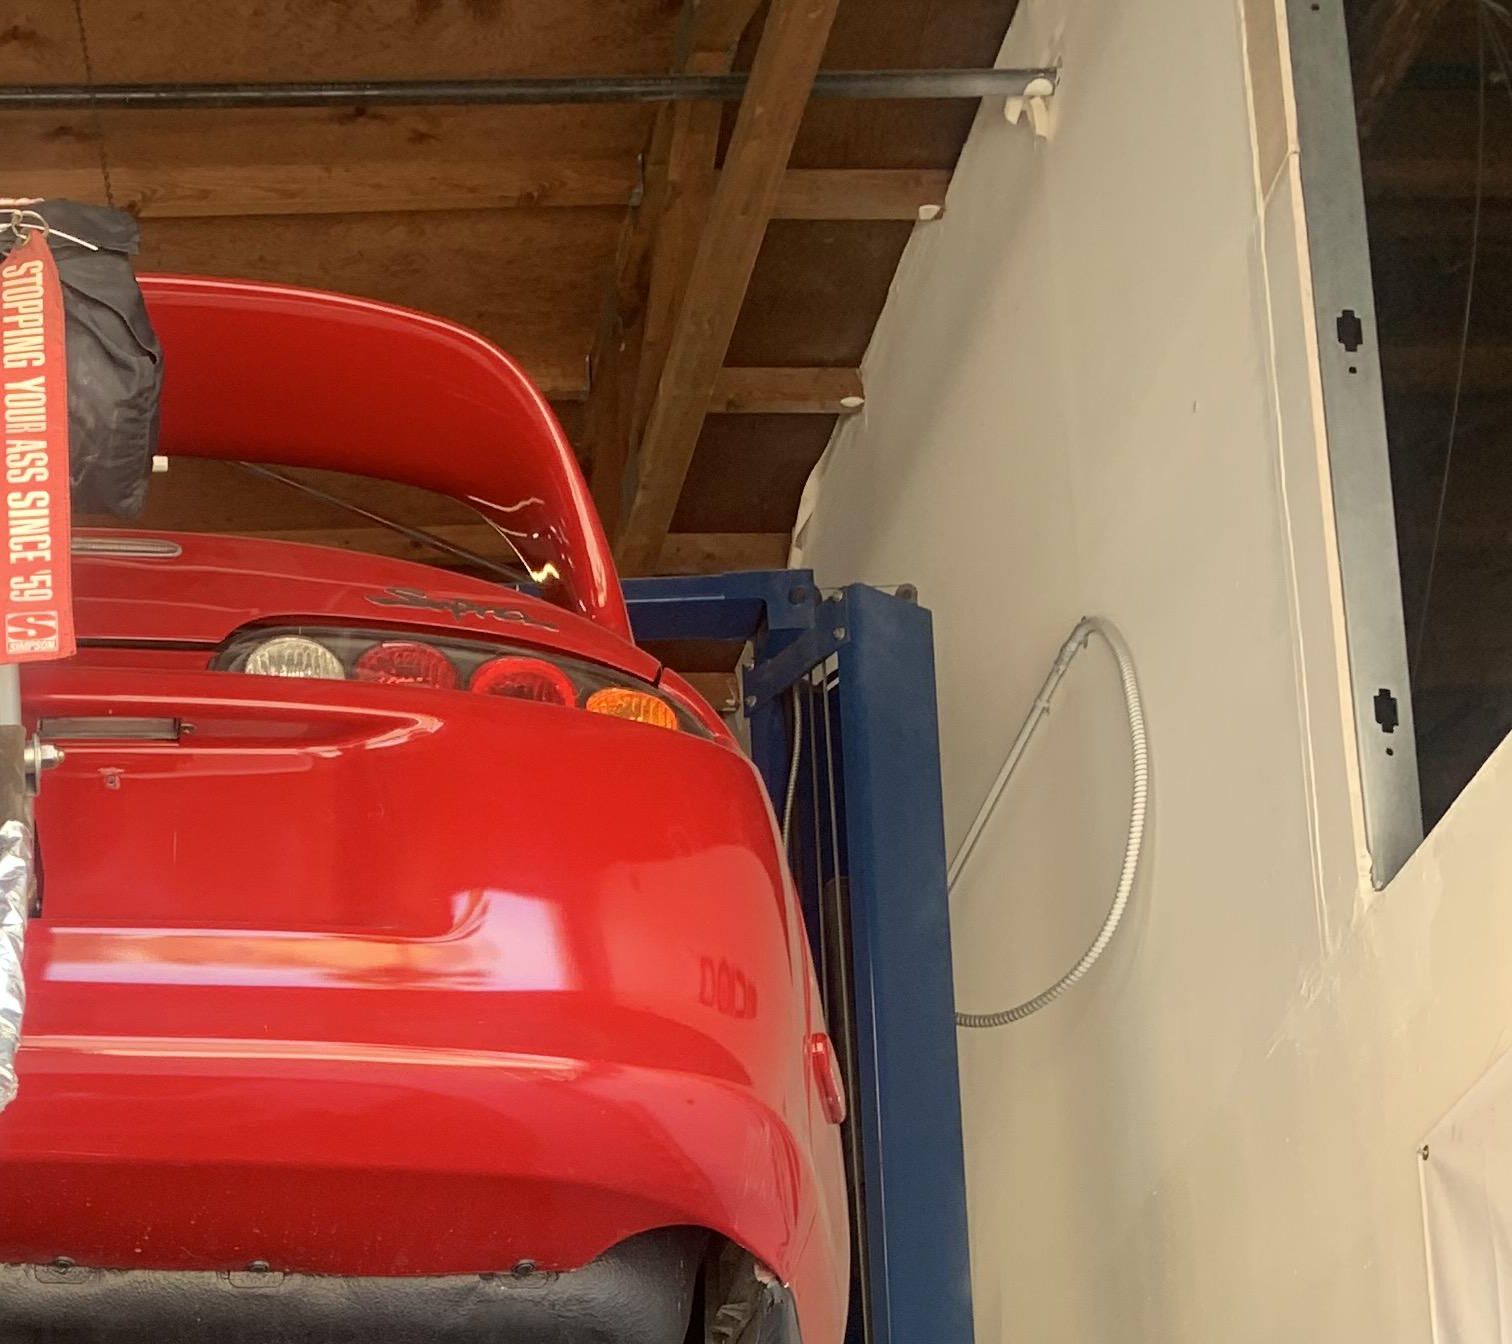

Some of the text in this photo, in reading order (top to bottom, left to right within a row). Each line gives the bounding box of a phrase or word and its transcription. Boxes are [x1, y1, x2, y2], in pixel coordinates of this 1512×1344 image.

[1, 259, 54, 602] STOPPING YOUR ASS SINCE '59
[7, 640, 58, 654] SIMPSON
